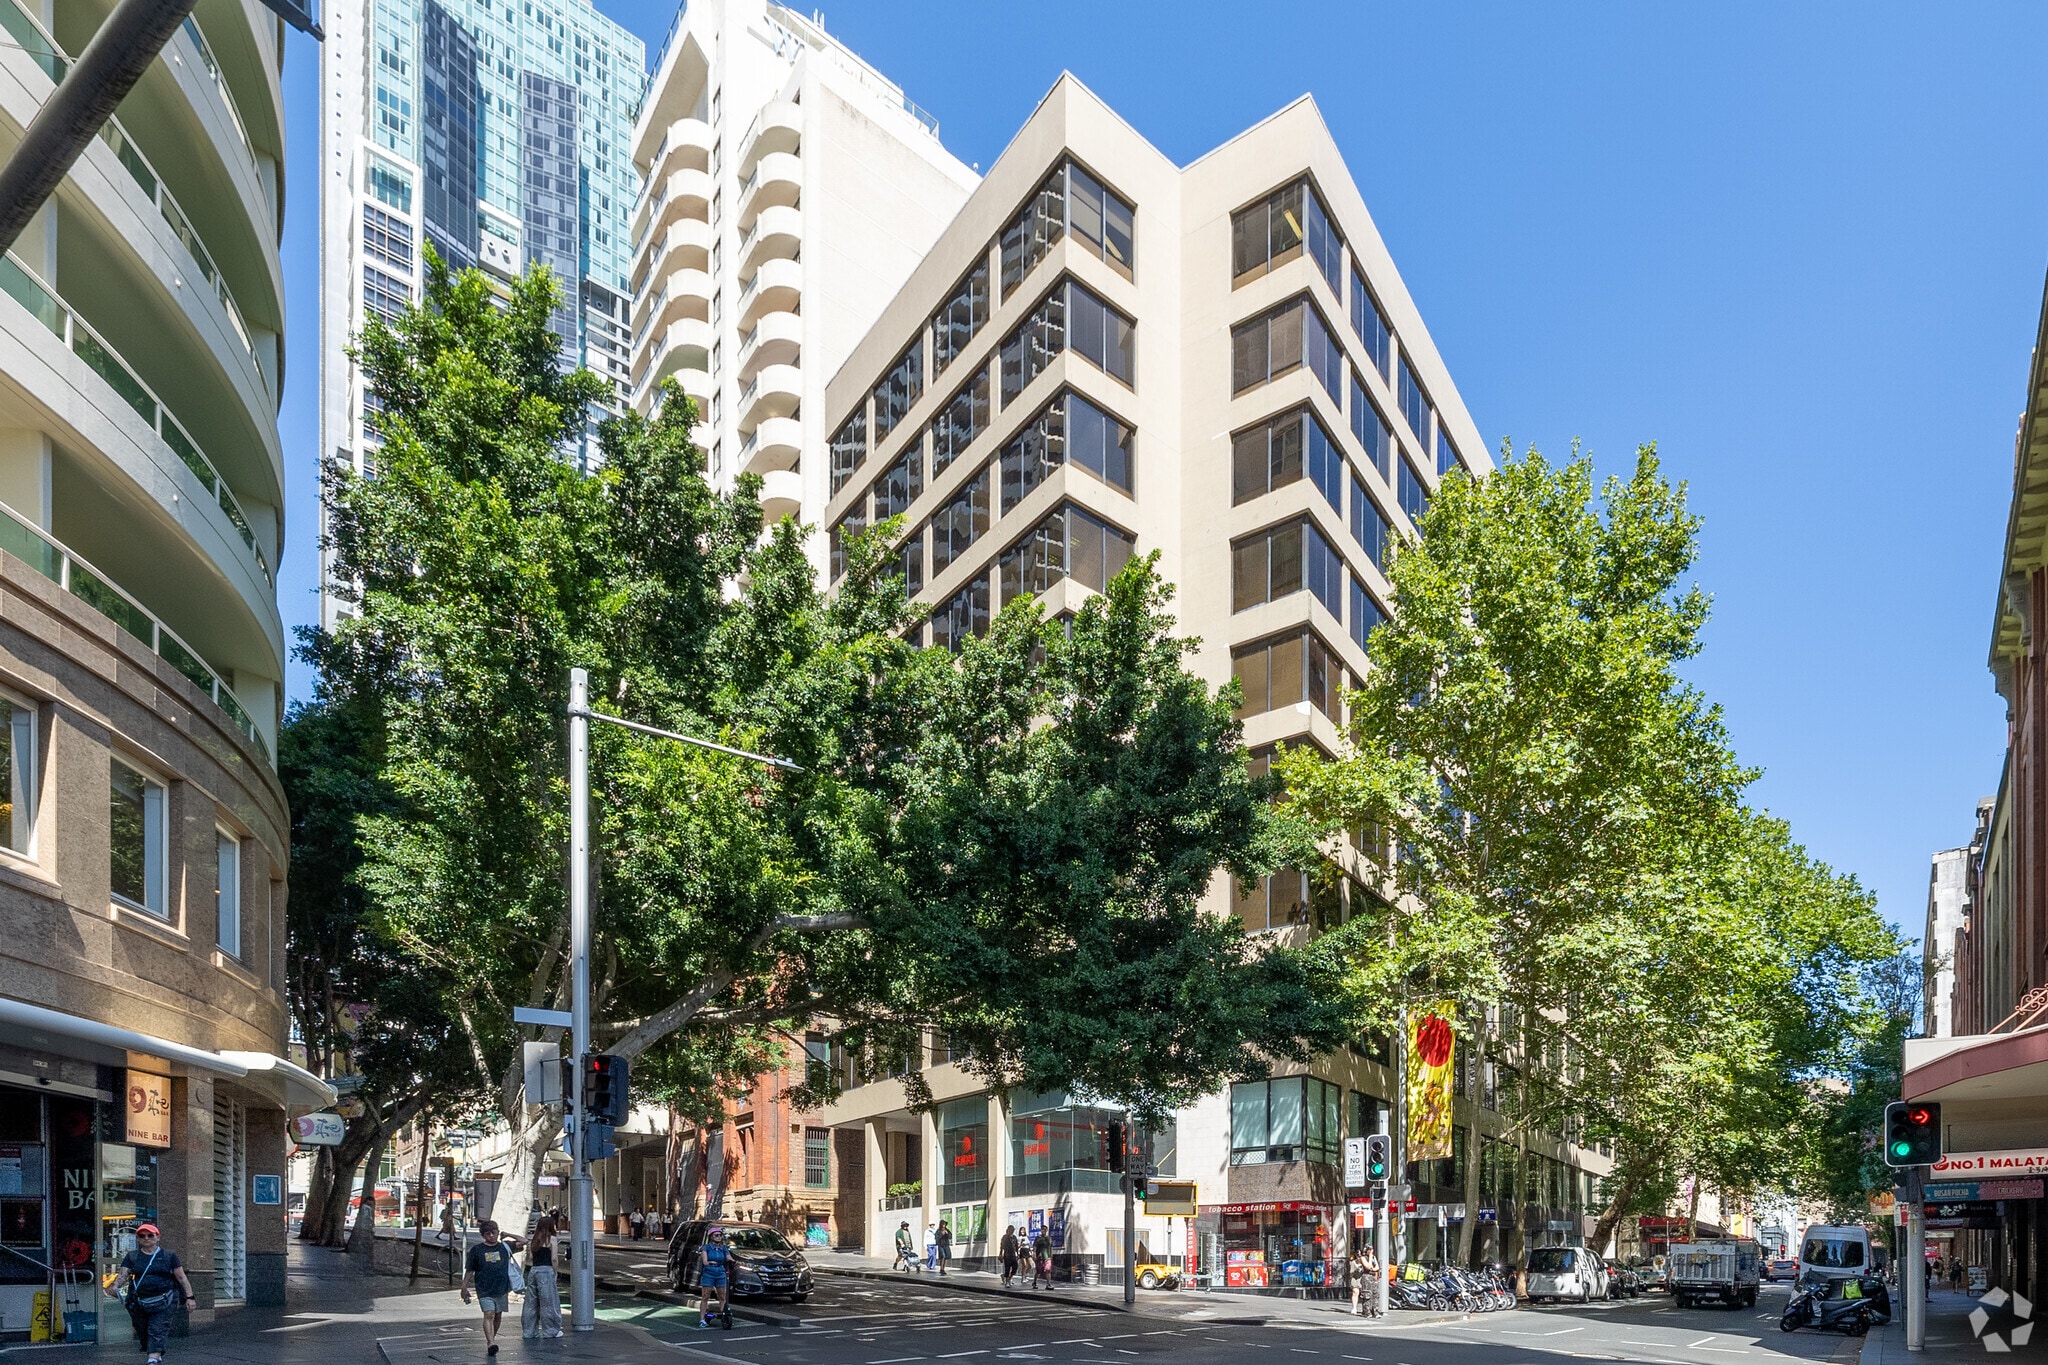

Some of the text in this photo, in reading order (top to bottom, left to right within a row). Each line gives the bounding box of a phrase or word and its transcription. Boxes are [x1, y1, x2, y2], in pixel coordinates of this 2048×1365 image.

[128, 1129, 169, 1142] NINE BAR
[1208, 1205, 1242, 1213] tobacco
[1245, 1203, 1276, 1211] station
